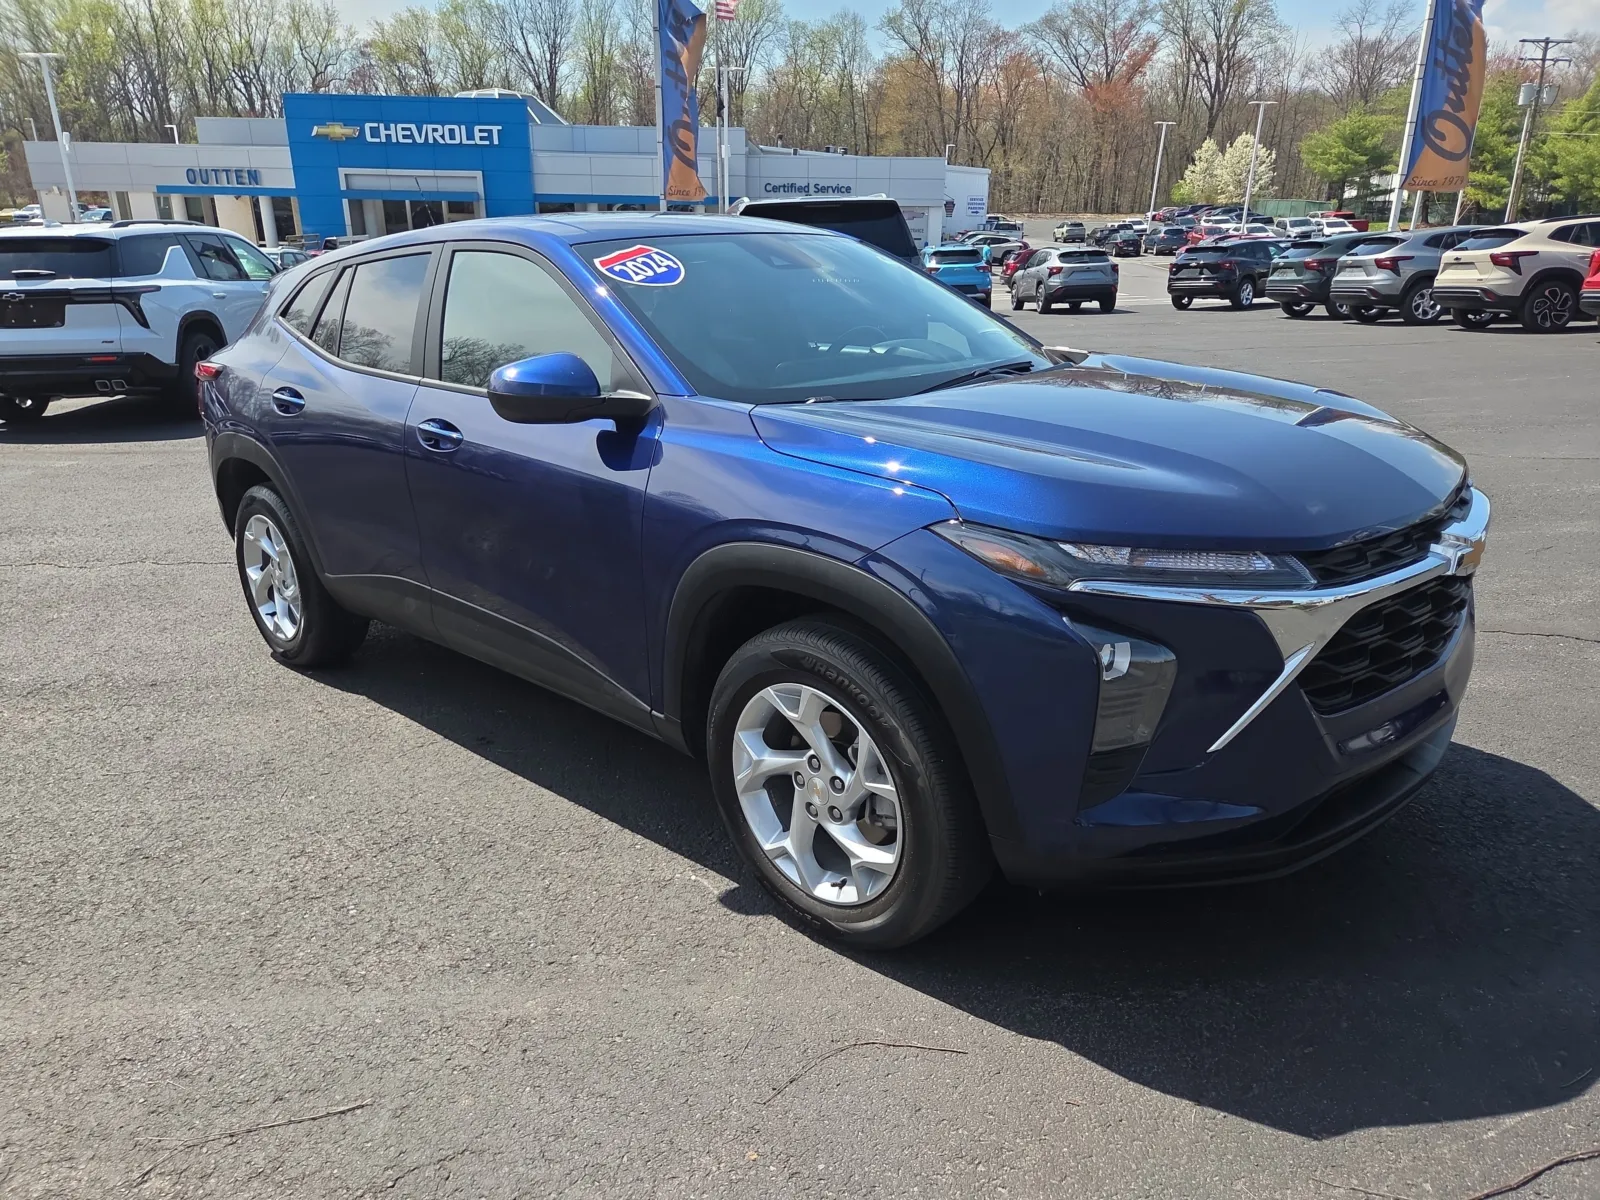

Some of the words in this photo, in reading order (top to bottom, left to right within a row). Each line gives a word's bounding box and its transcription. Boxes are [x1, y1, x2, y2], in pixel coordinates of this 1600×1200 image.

[364, 122, 502, 145] CHEVROLET
[186, 167, 261, 187] OUTTEN
[1407, 175, 1438, 187] Since
[668, 185, 690, 196] Since
[764, 182, 810, 194] Certified
[813, 183, 852, 194] Service
[613, 253, 679, 282] 2024
